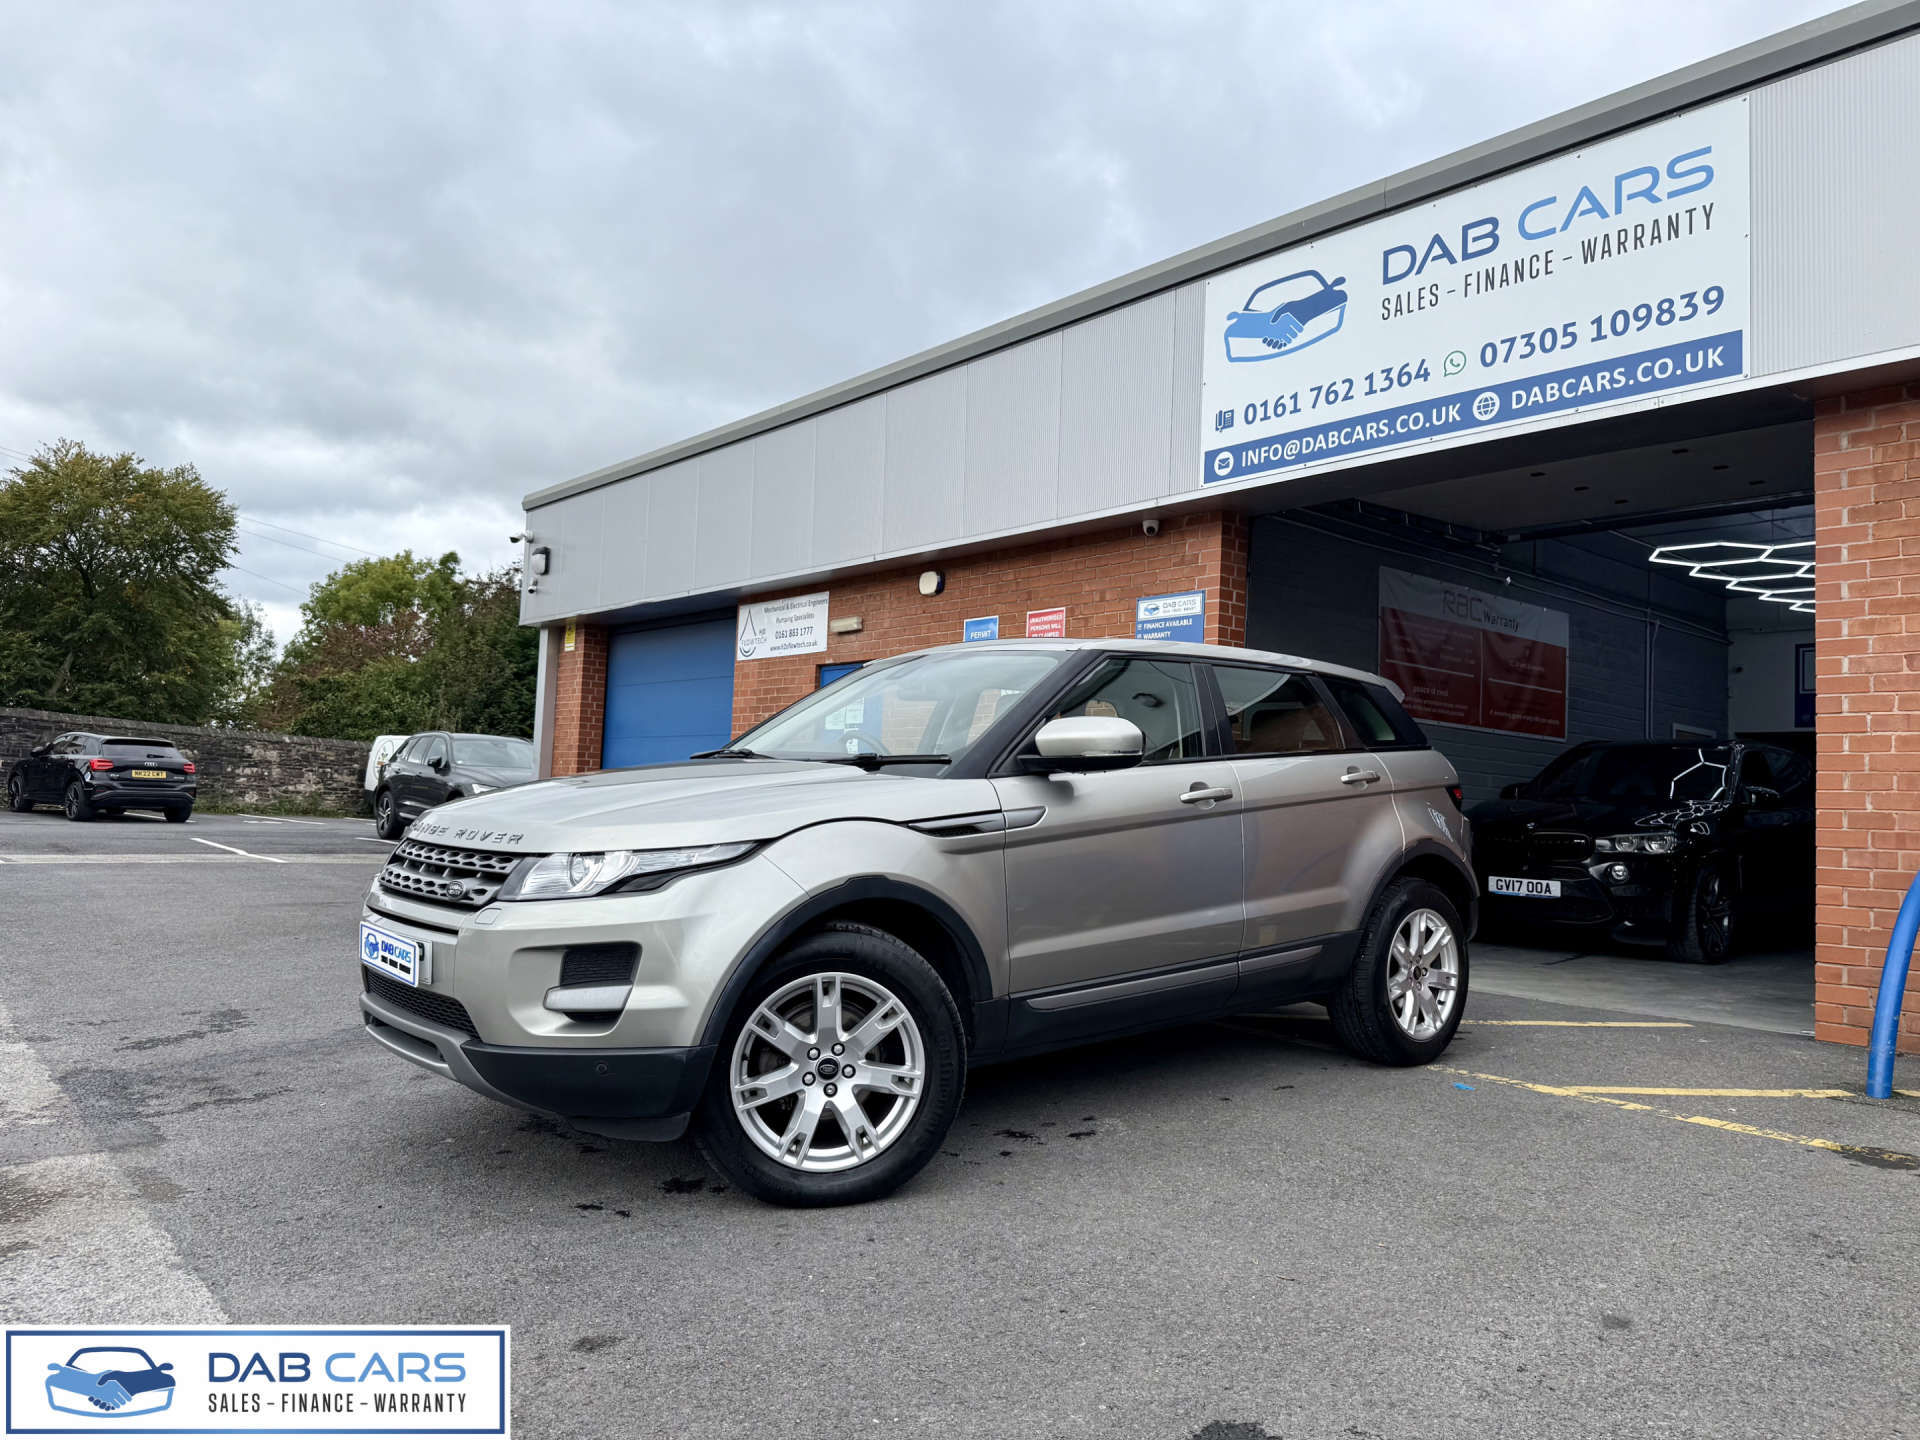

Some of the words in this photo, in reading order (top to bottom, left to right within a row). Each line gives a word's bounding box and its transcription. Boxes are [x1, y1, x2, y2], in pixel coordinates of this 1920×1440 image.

[1382, 216, 1500, 286] DAB
[1517, 145, 1714, 241] CARS
[1381, 283, 1439, 321] SALES
[1464, 250, 1554, 298] FINANCE
[1581, 202, 1714, 265] WARRANTY
[1480, 325, 1578, 369] 07305
[1589, 284, 1725, 342] 109839
[1243, 390, 1302, 426] 0161
[1309, 377, 1355, 411] 762
[1363, 358, 1430, 397] 1364
[1511, 345, 1725, 410] DABCARS.CO.UK
[1240, 402, 1462, 468] INFO@DABCARS.CO.UK
[1143, 621, 1165, 630] FINANCE
[1165, 618, 1193, 628] AVAILABLE
[1162, 601, 1176, 609] DAB
[970, 630, 992, 640] PERMIT
[1143, 631, 1171, 640] WARRANTY
[454, 828, 525, 845] ROVER
[1495, 878, 1523, 892] GV17
